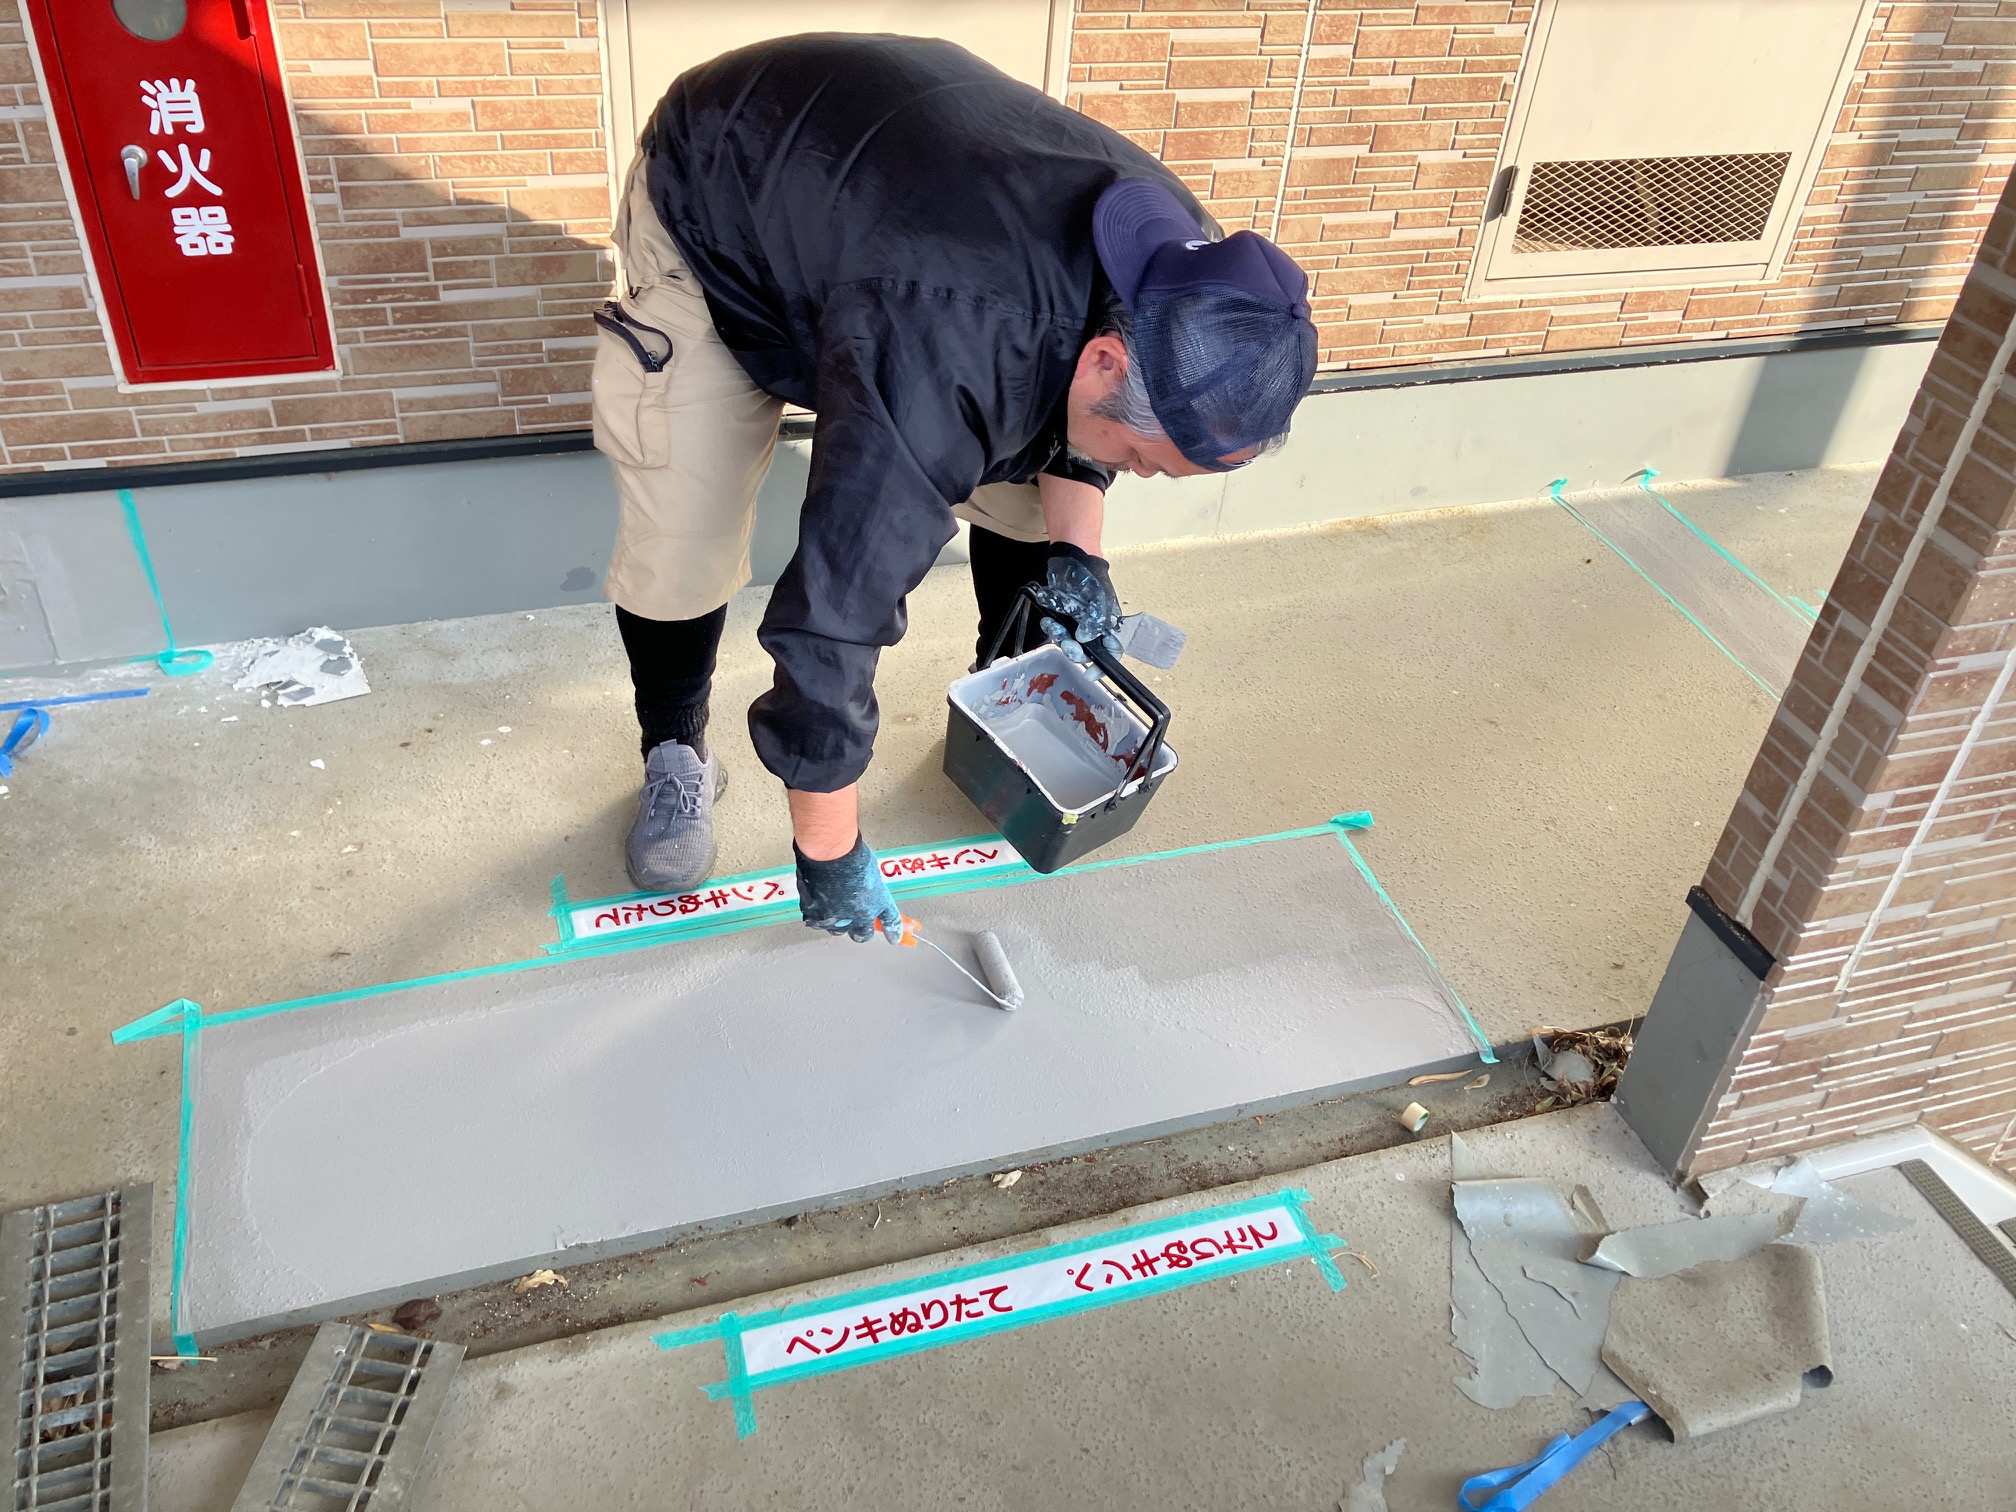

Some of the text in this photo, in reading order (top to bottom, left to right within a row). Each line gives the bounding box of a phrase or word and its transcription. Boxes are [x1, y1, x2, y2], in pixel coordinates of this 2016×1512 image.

[139, 78, 235, 257] 消火器
[880, 848, 999, 878] ペンキぬり
[594, 881, 785, 929] ペンキぬりたて
[1067, 1221, 1279, 1292] ペンキぬりたて
[786, 1285, 1014, 1355] ペンキぬりたて
